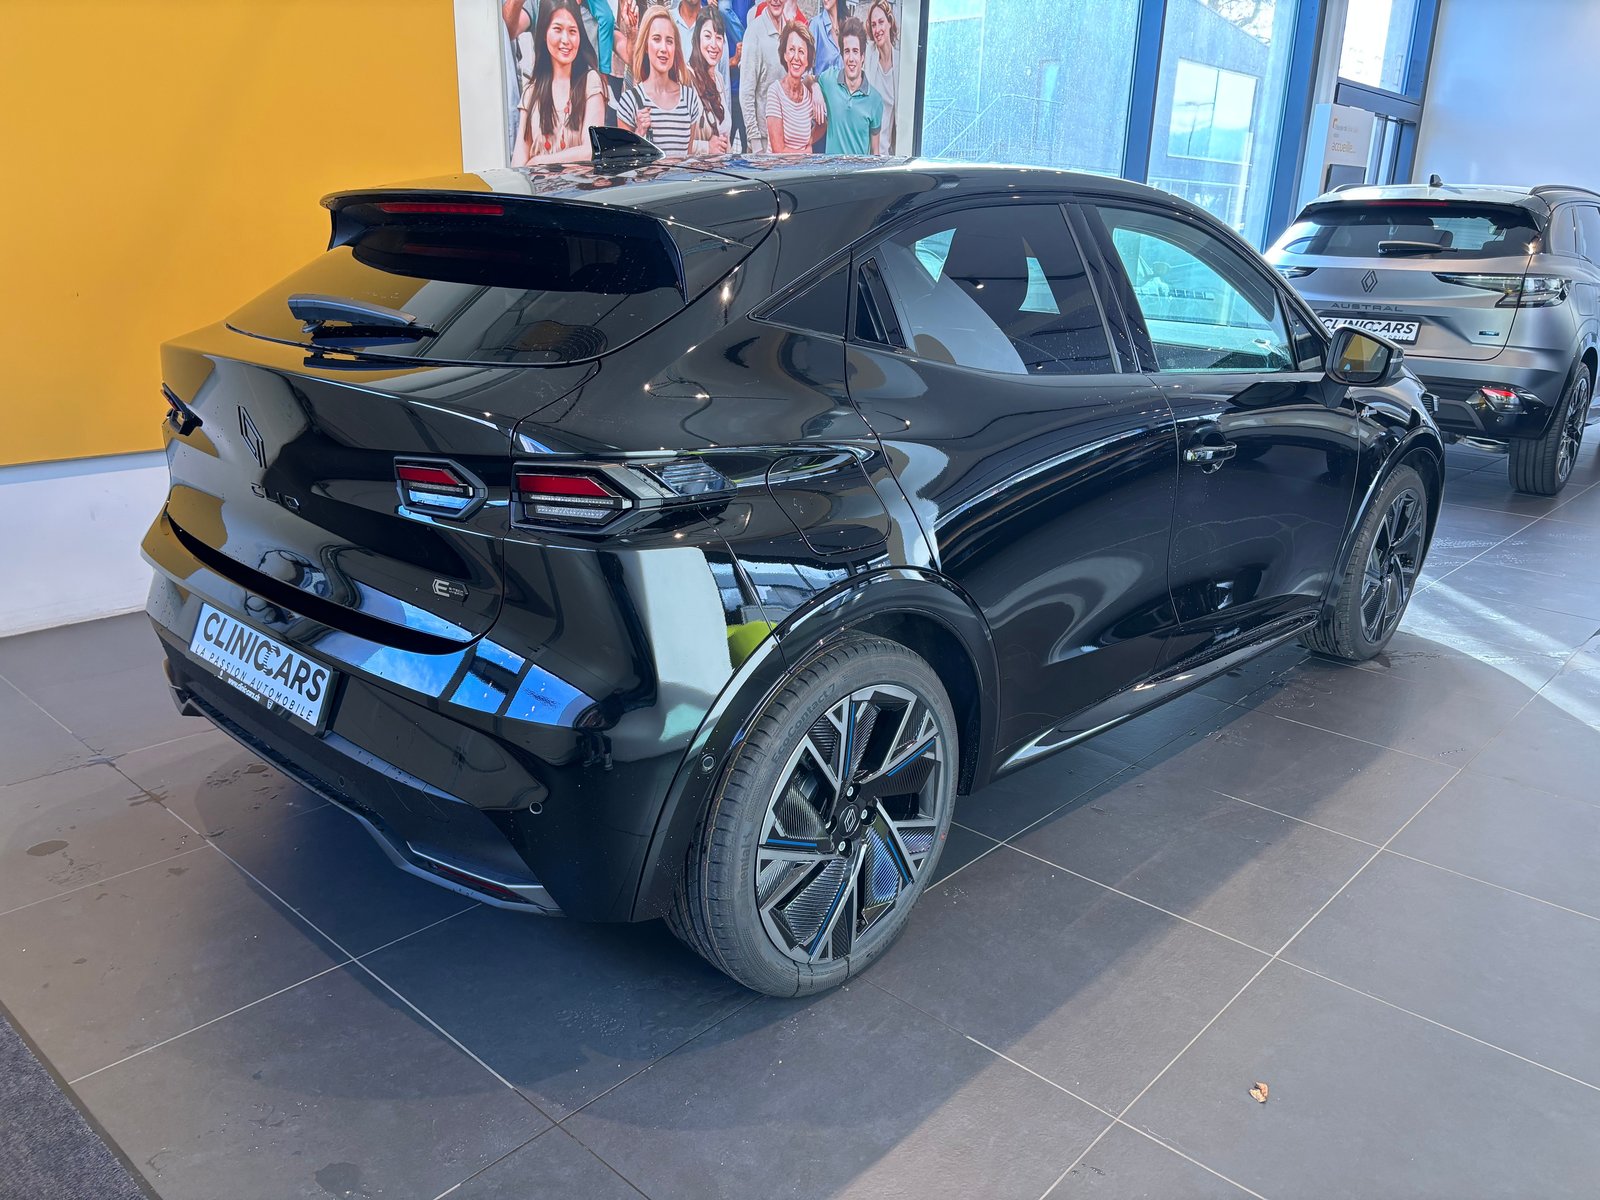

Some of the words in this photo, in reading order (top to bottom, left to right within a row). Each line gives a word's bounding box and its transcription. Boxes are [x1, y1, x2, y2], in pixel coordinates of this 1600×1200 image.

[1330, 302, 1404, 313] AUSTRAL
[195, 644, 206, 656] LA
[208, 652, 247, 681] PASSION
[250, 677, 313, 720] AUTOMOBILE
[204, 612, 327, 702] CLINICCARS
